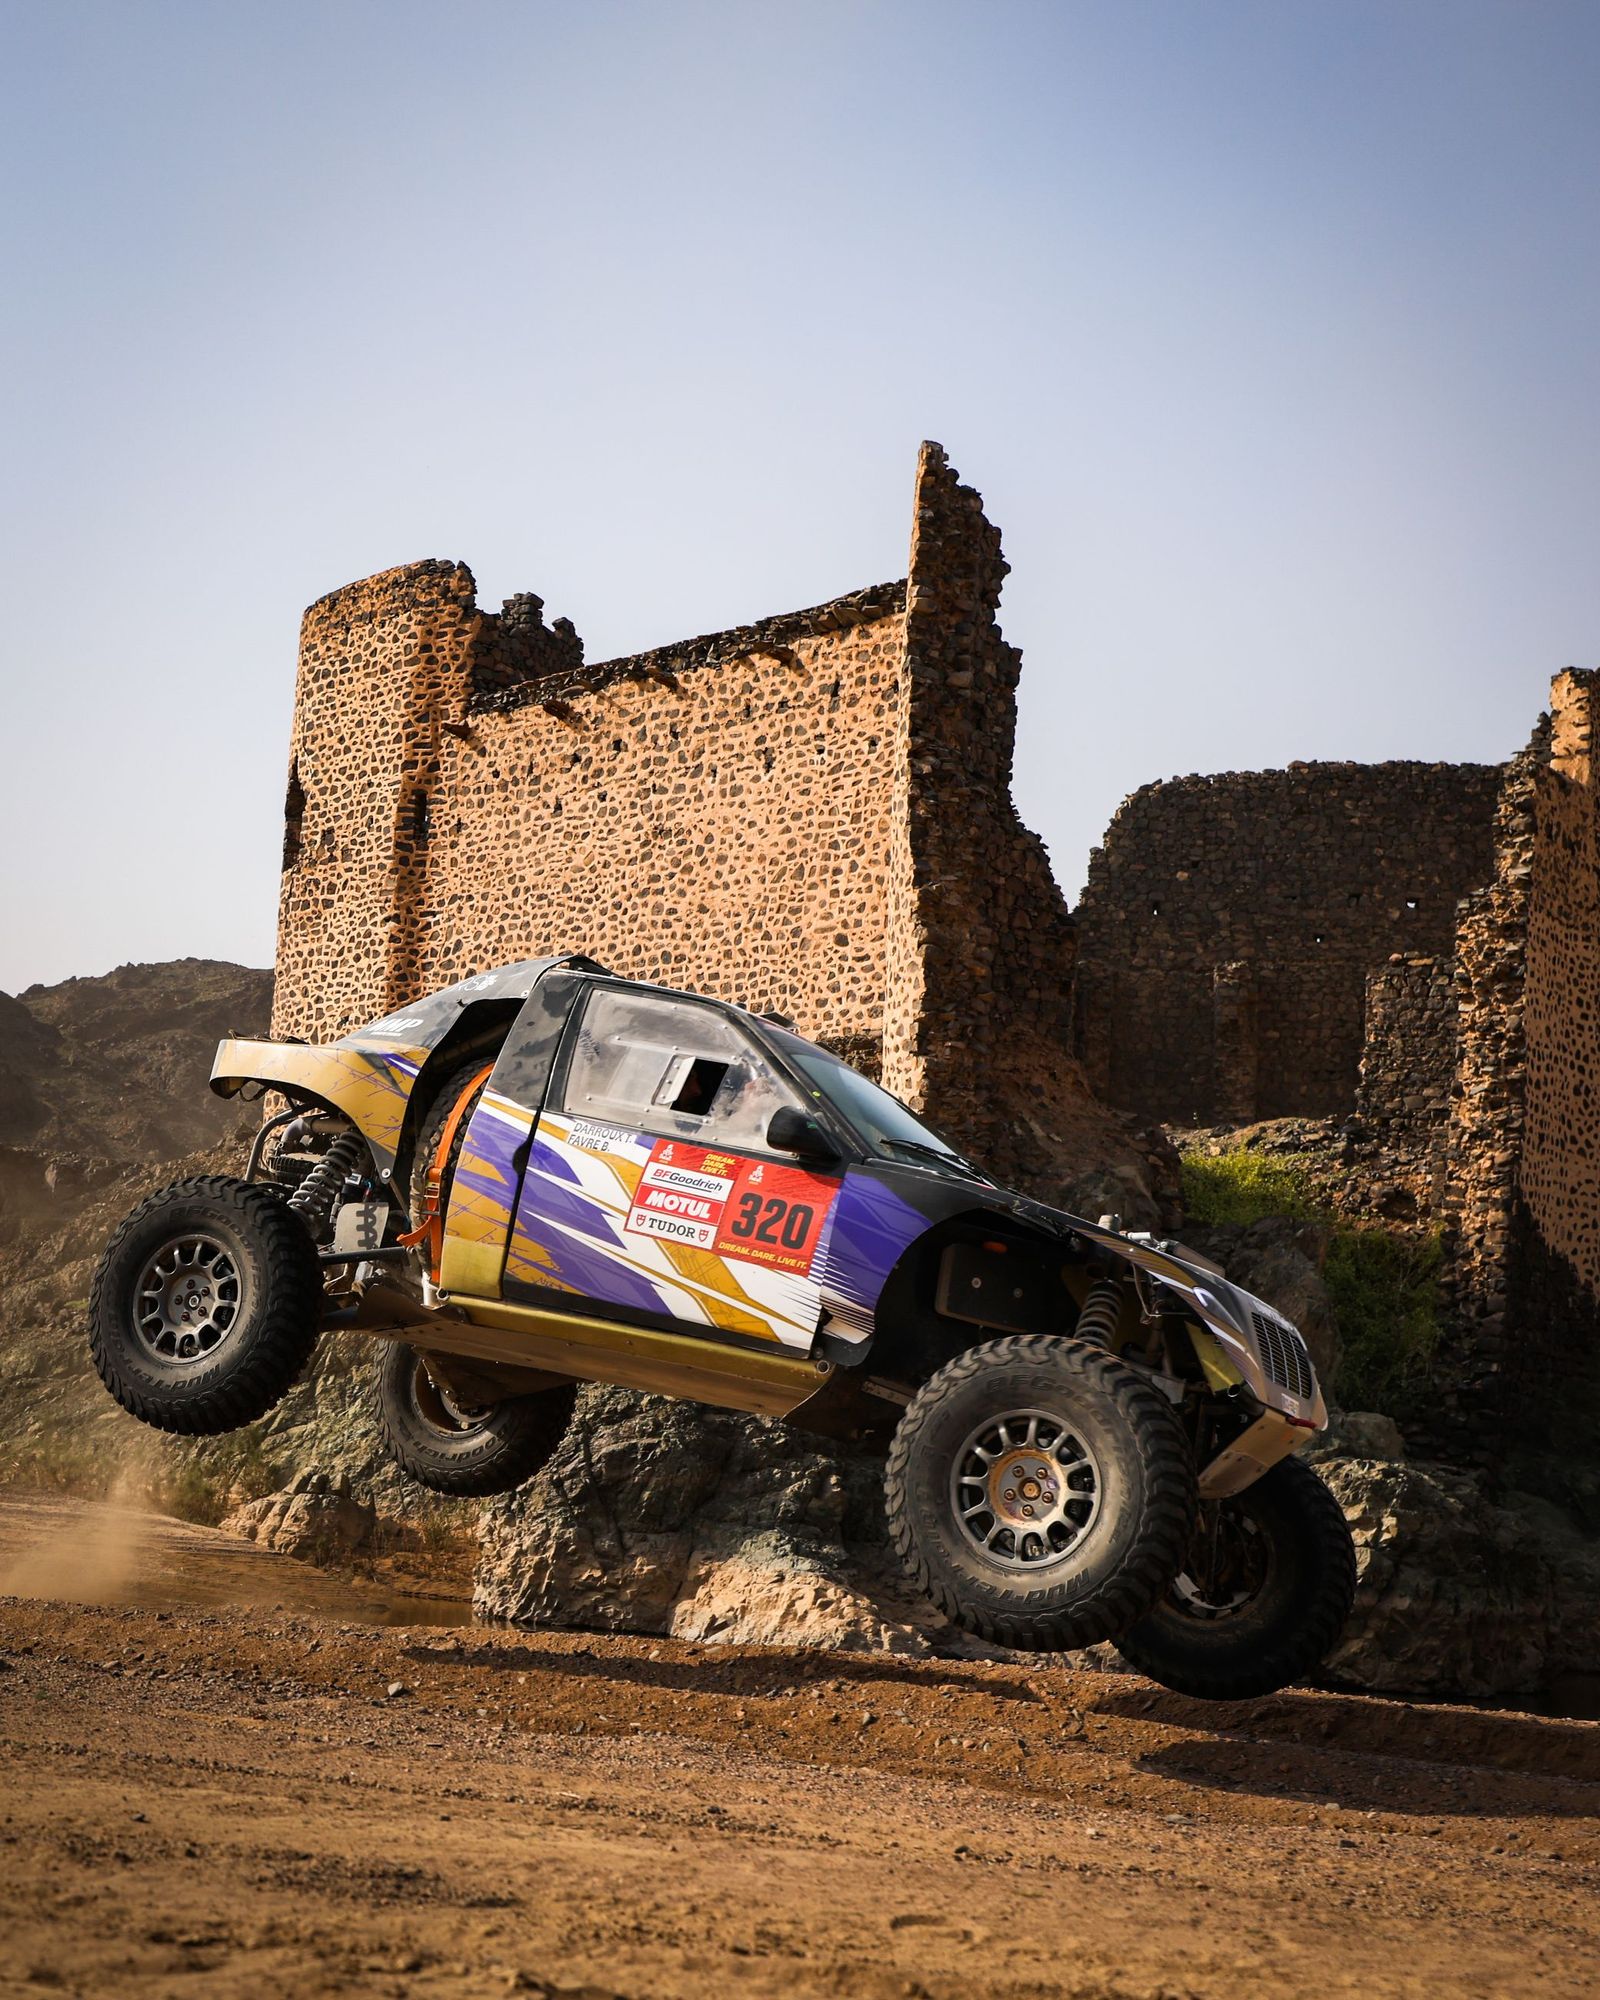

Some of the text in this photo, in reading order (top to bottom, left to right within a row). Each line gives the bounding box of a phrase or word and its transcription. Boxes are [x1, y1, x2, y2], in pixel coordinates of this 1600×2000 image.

[567, 1134, 610, 1152] FAVRE B.
[573, 1122, 632, 1143] DARROUX T.
[703, 1159, 726, 1169] DARE.
[705, 1153, 737, 1165] DREAM.
[653, 1168, 723, 1191] BFGoodrich
[700, 1165, 718, 1175] LIVE
[644, 1190, 712, 1219] MOTUL
[648, 1218, 696, 1239] TUDOR
[731, 1192, 814, 1250] 320
[718, 1241, 807, 1269] DREAM. DARE. LIVE IT.
